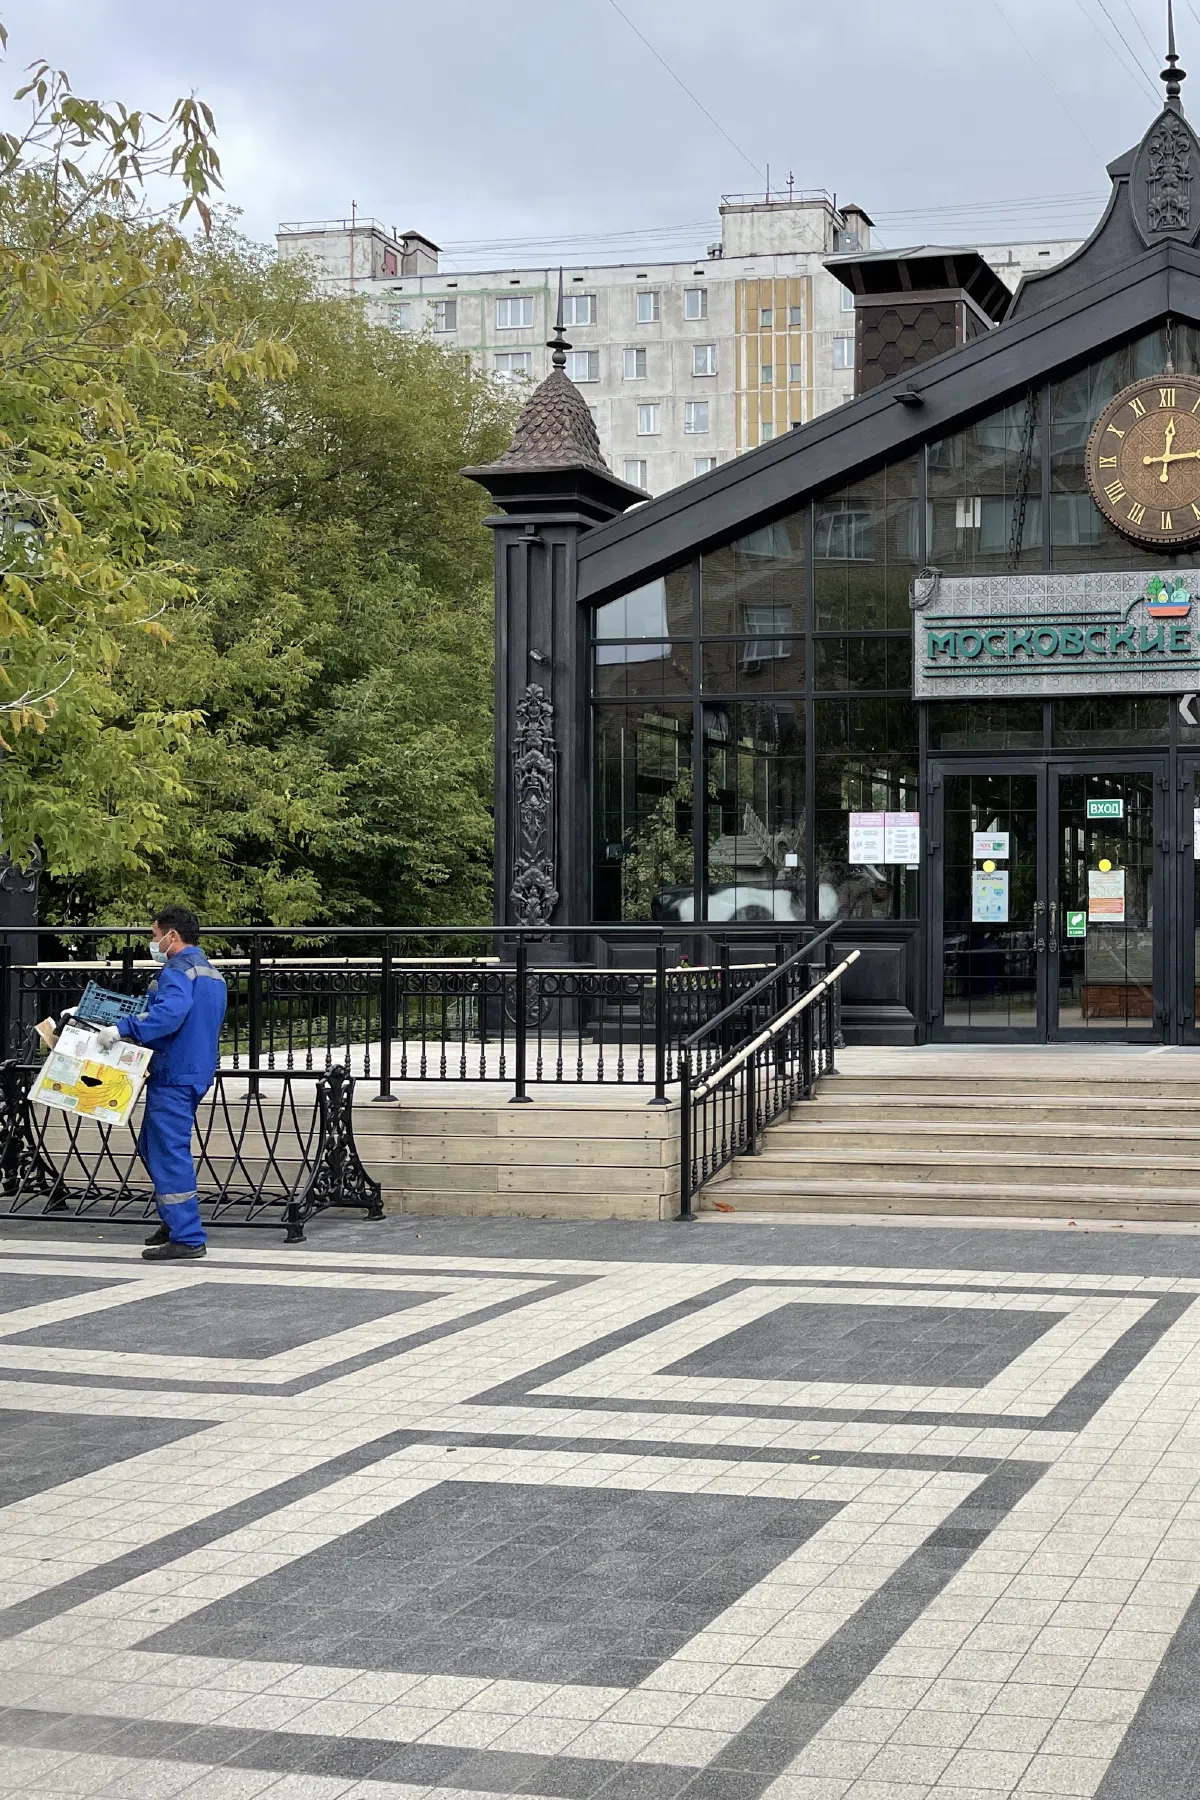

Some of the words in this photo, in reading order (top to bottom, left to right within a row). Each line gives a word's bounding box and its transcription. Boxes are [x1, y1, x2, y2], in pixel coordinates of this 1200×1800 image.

[1128, 397, 1147, 419] XI
[1159, 388, 1175, 408] XII
[1106, 423, 1125, 439] X
[1104, 479, 1127, 505] VIII
[1127, 502, 1146, 526] VII
[1160, 511, 1173, 530] VI
[926, 624, 1192, 660] МОСКОВСКИЕ
[1090, 803, 1119, 815] ВХОД
